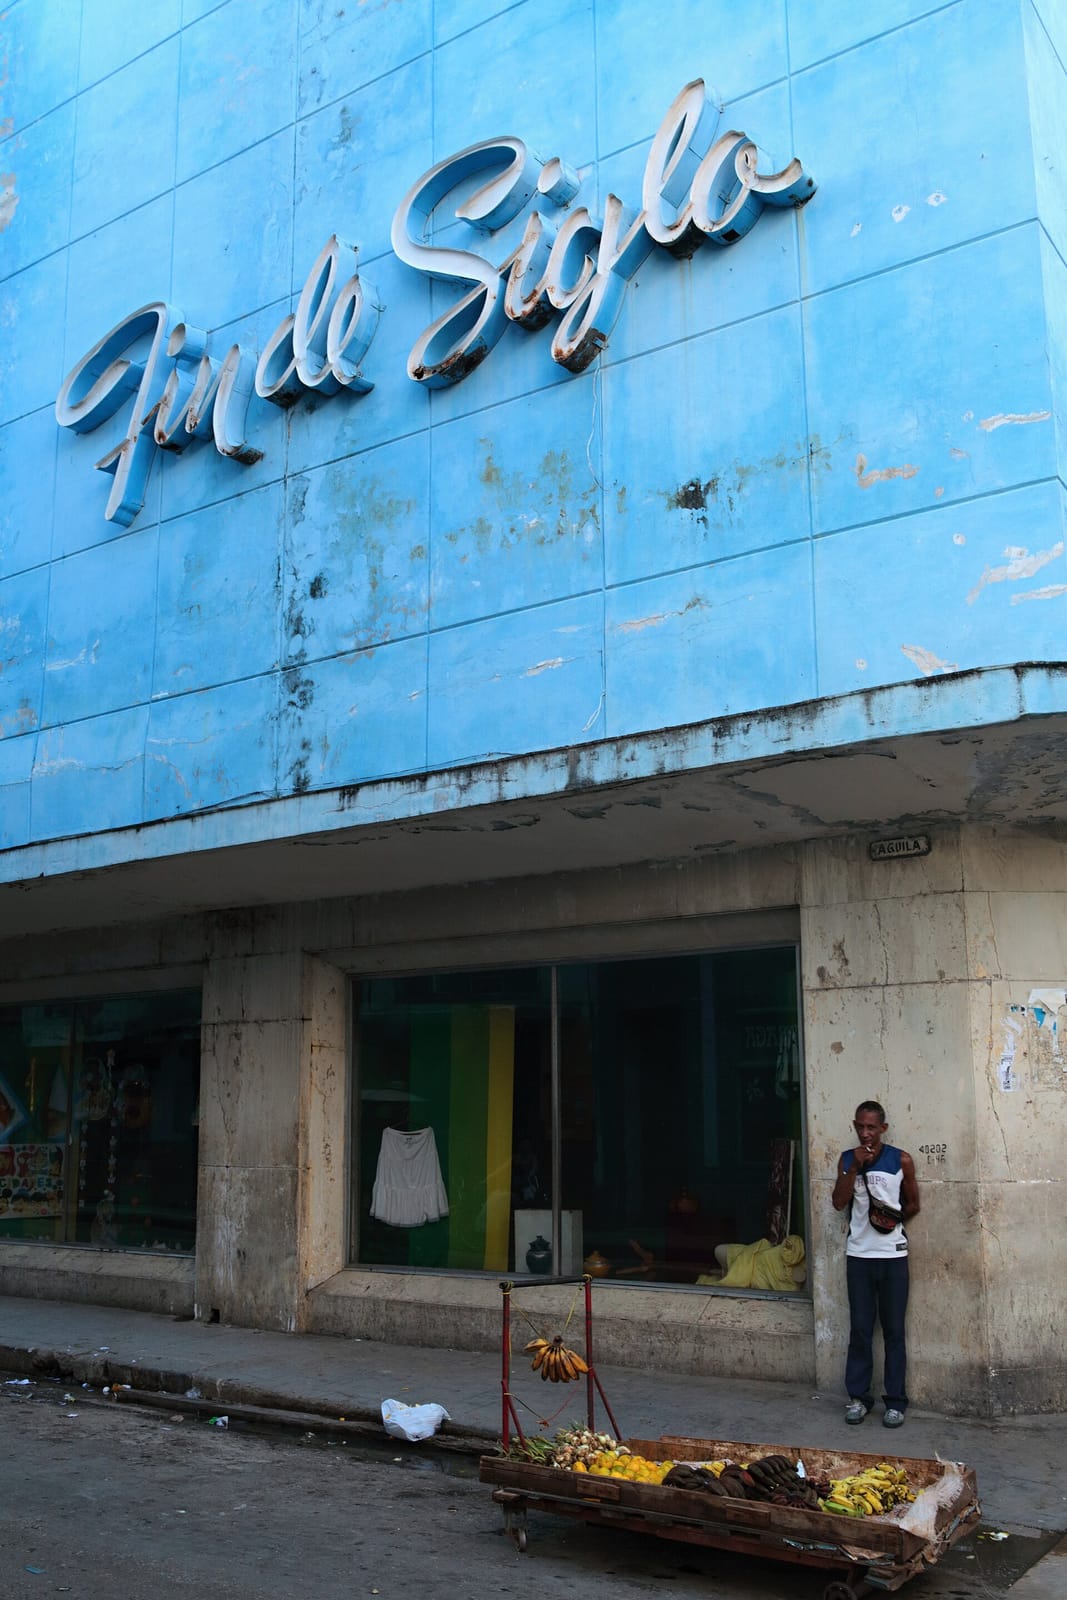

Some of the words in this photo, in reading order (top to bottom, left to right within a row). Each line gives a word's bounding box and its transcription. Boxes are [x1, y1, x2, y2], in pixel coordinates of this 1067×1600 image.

[55, 302, 264, 526] Fin
[254, 234, 384, 405] de
[390, 78, 818, 388] Siglo
[878, 840, 921, 855] AGUILA
